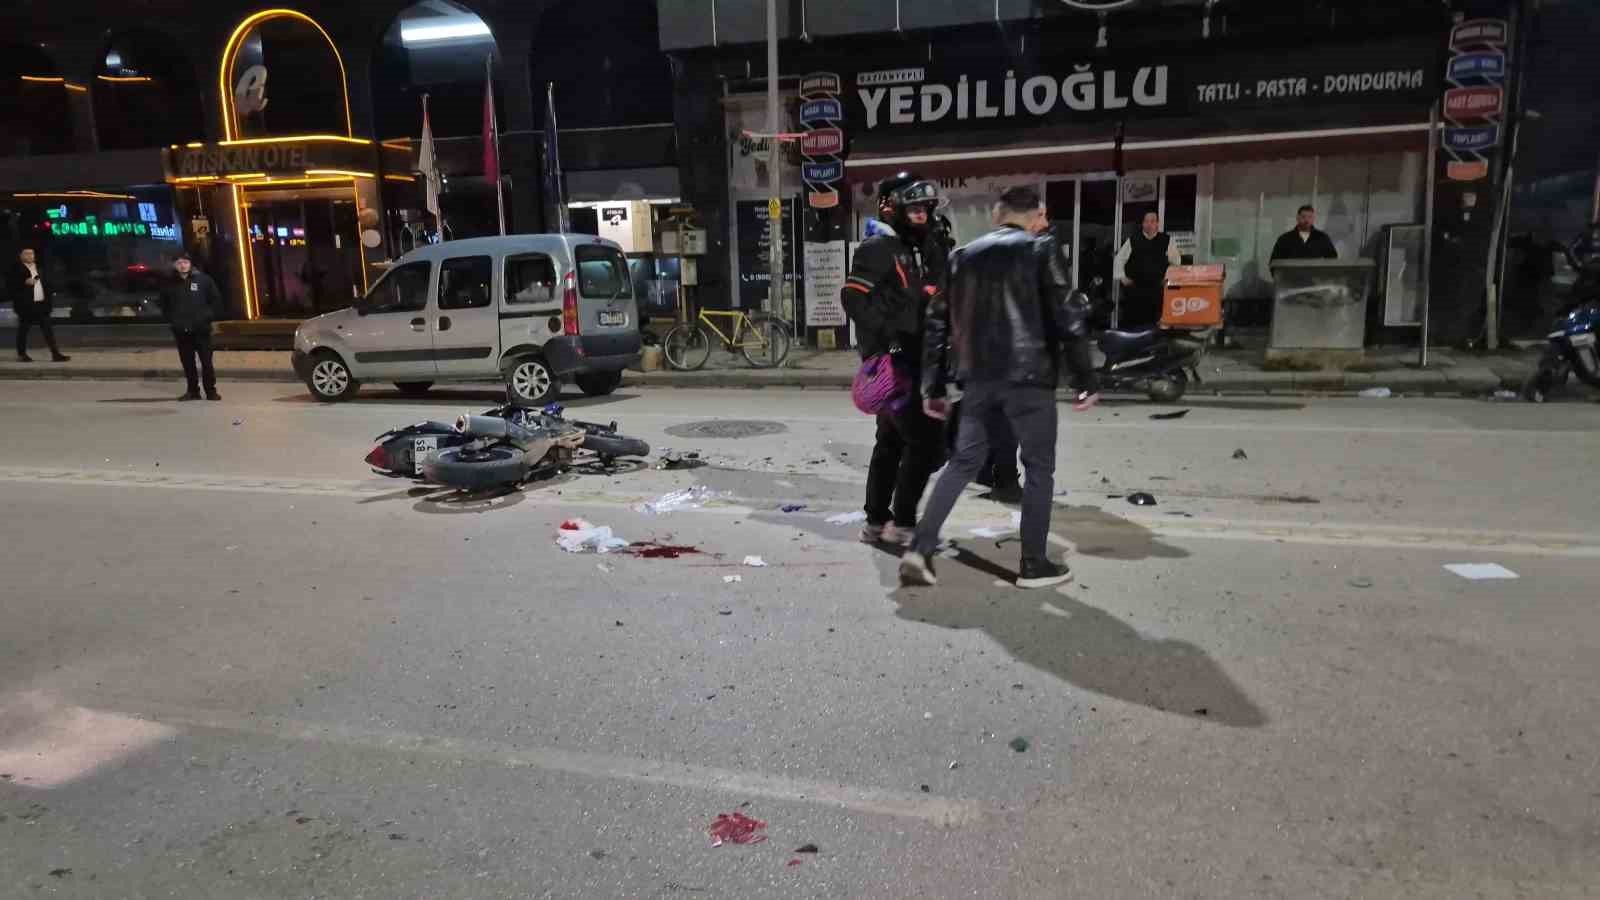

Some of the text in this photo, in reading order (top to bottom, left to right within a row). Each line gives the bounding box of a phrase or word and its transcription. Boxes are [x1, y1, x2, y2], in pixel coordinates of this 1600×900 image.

[857, 63, 1168, 129] YEDİLİOĞLU
[1197, 82, 1240, 102] TATLI
[1257, 77, 1308, 98] PASTA
[1324, 69, 1424, 93] DONDURMA
[264, 144, 315, 168] OTEL
